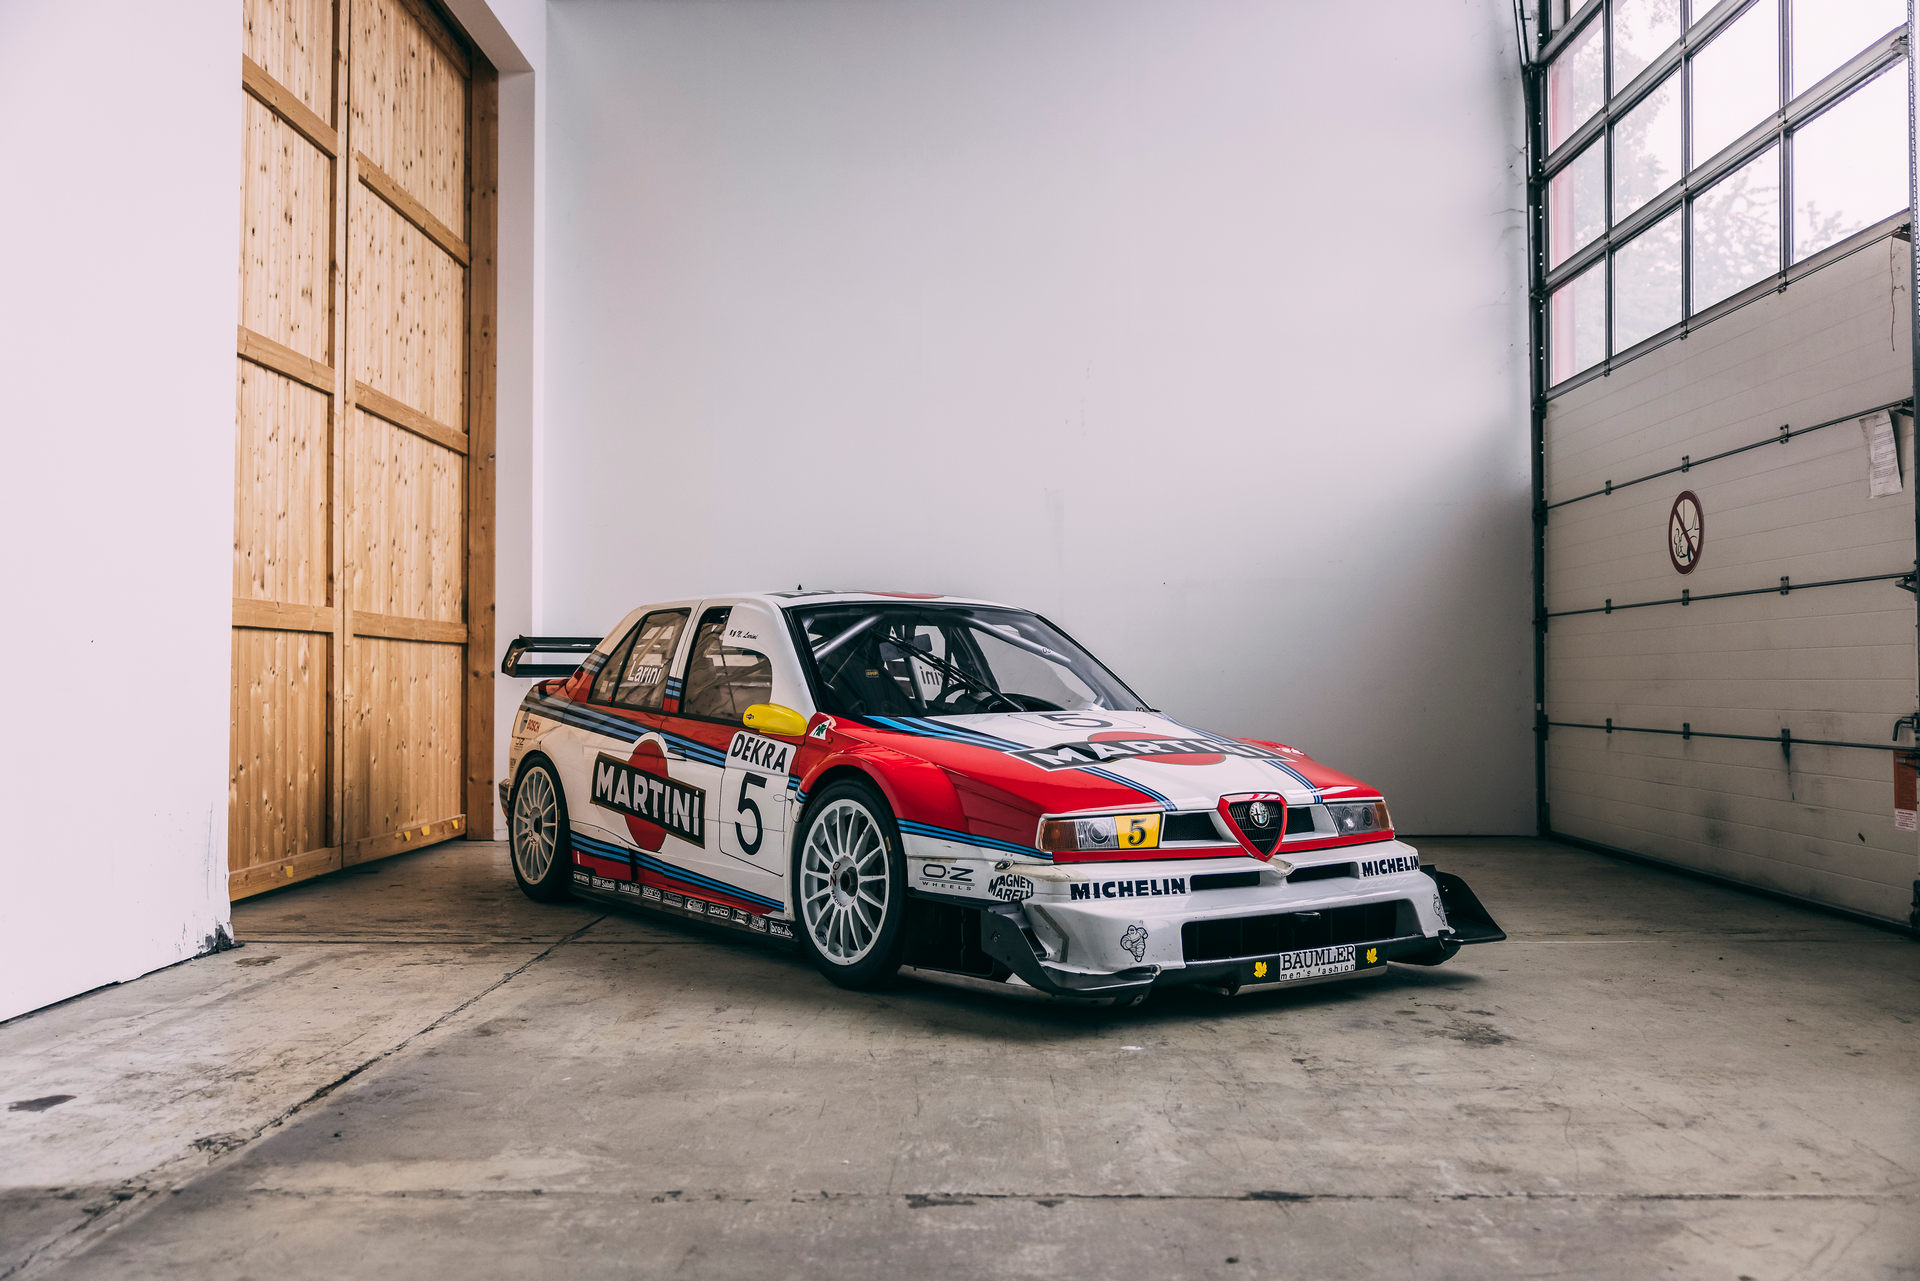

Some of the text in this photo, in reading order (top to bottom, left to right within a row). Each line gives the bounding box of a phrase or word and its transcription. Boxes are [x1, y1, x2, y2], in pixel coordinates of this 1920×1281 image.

[627, 660, 664, 685] Larini
[1038, 713, 1113, 728] 5
[730, 733, 788, 773] DEKRA
[1029, 739, 1274, 766] MARTINI
[595, 761, 700, 836] MARTINI
[735, 771, 768, 856] 5
[1127, 818, 1148, 846] 5
[1361, 855, 1420, 878] MICHELIN
[922, 881, 972, 891] WHEELS
[987, 873, 1034, 896] MAGNETI
[987, 880, 1034, 902] MARELLI
[1069, 877, 1186, 901] MICHELIN
[1280, 945, 1356, 971] BÄUMLER
[1280, 969, 1312, 980] men's
